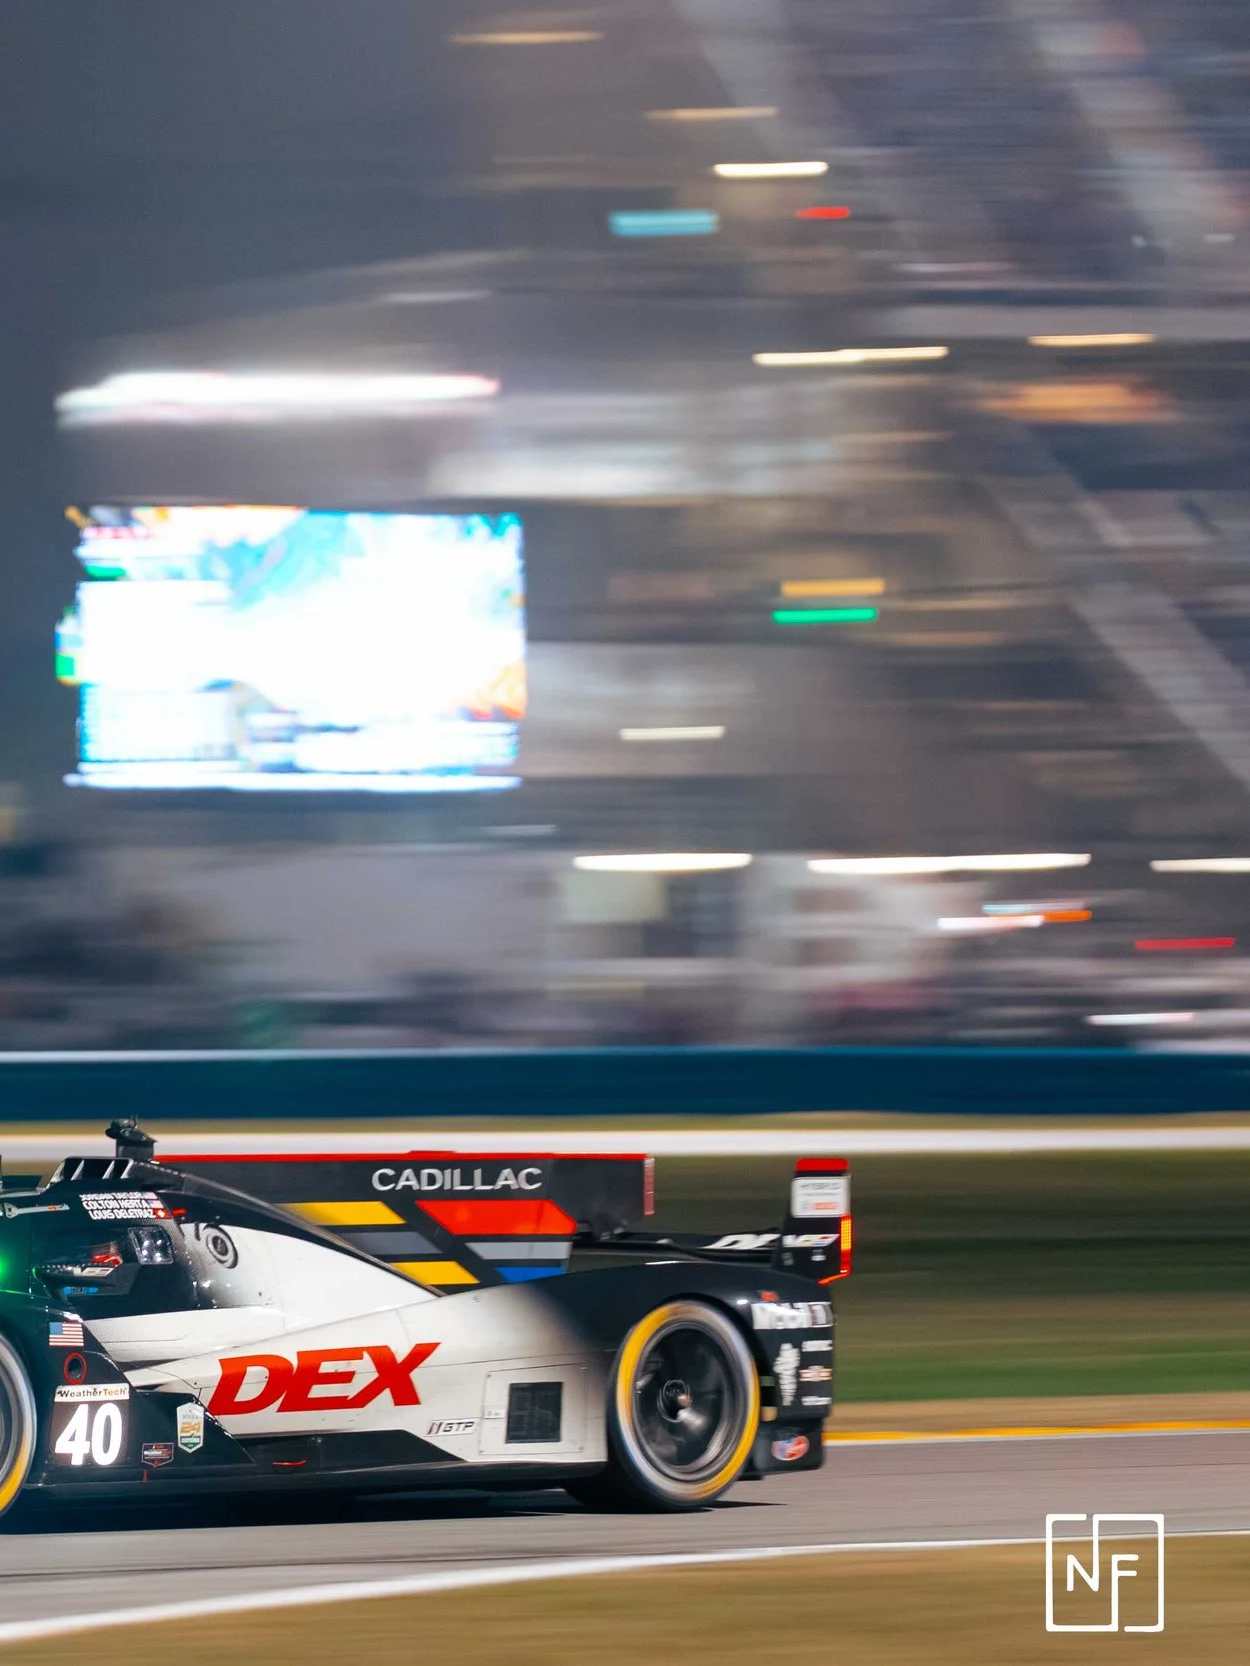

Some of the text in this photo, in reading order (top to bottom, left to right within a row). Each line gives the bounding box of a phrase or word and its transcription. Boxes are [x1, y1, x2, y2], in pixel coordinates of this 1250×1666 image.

[372, 1168, 542, 1191] CADILLAC
[82, 1199, 150, 1210] COLTON HERTA
[88, 1209, 116, 1220] LOUIS
[206, 1342, 441, 1416] DEX
[57, 1388, 127, 1398] WeatherTech
[55, 1402, 123, 1466] 40
